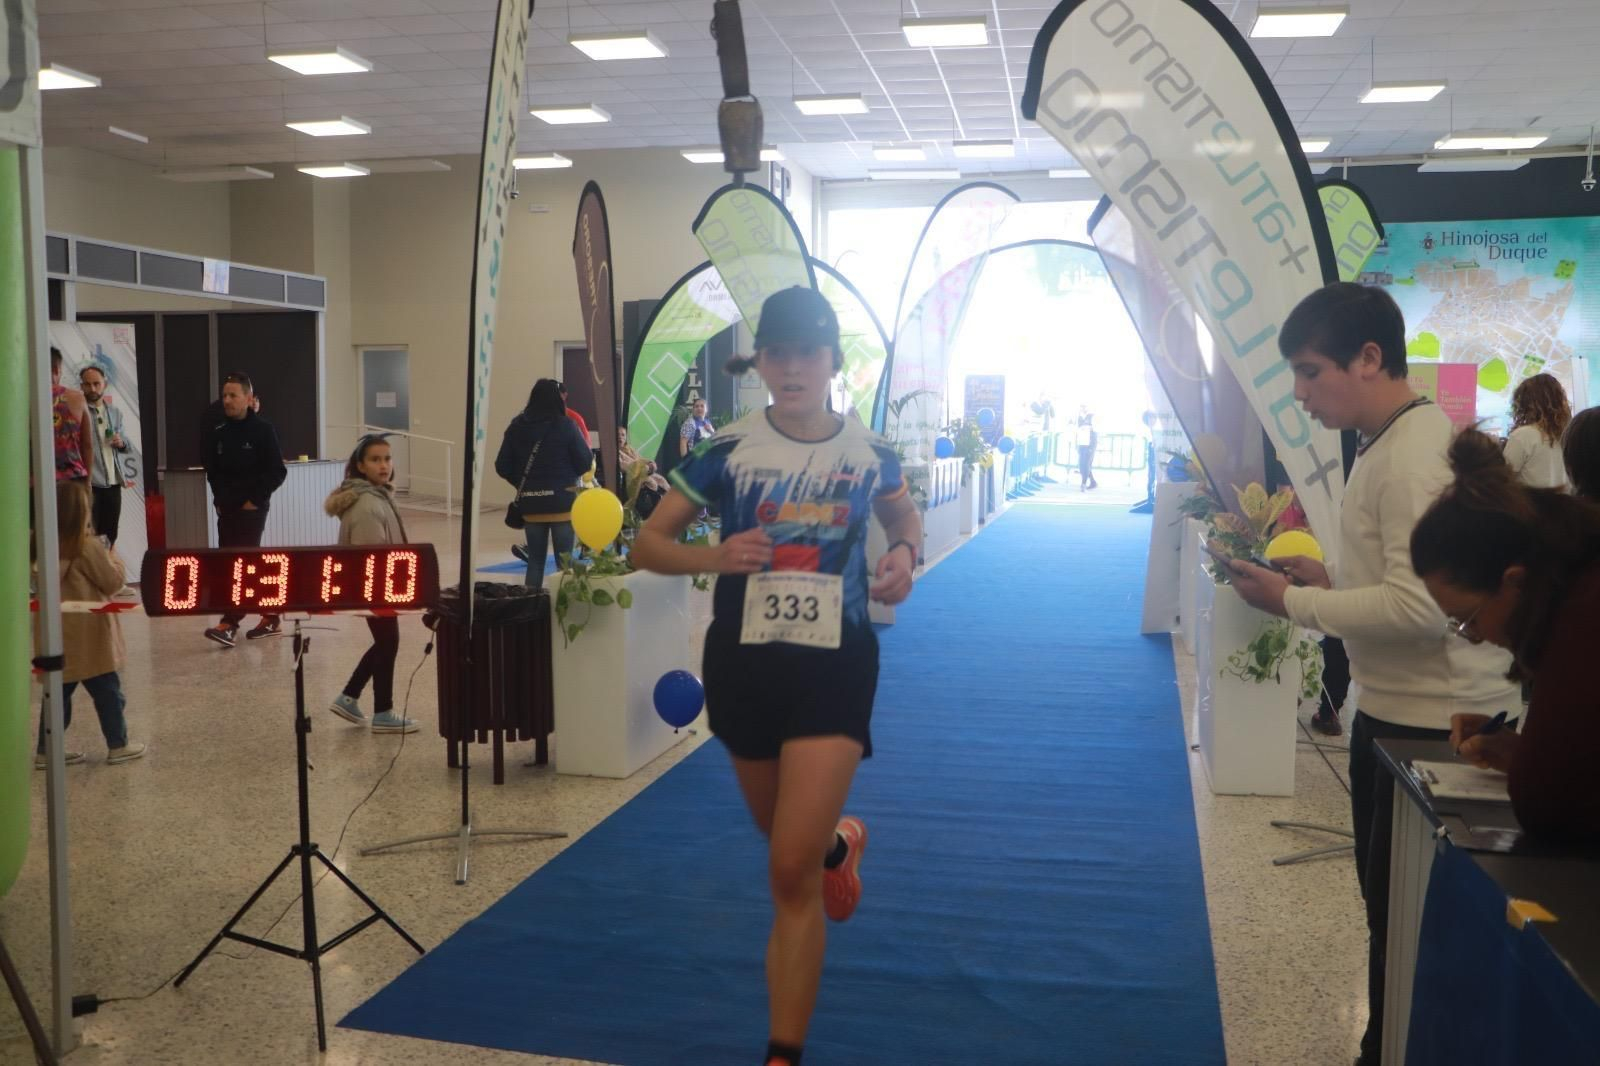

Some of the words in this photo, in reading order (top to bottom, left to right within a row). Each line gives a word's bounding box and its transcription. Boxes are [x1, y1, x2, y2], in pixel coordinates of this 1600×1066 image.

[1441, 231, 1519, 251] Hinojosa
[1527, 231, 1547, 244] del
[1488, 245, 1548, 262] Duque
[764, 594, 819, 622] 333
